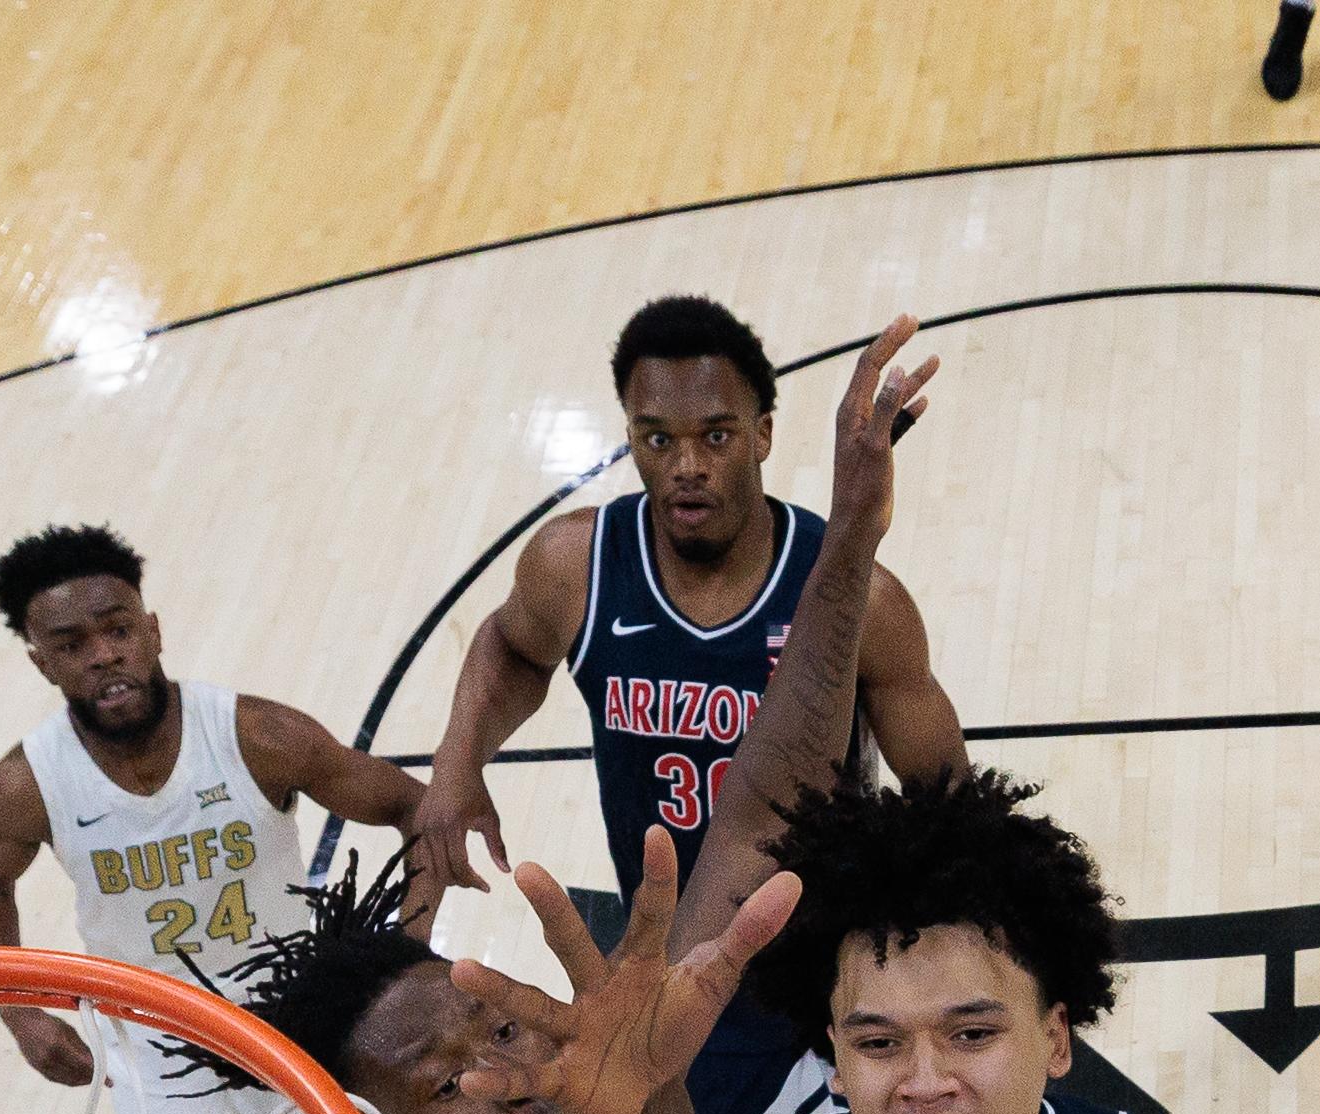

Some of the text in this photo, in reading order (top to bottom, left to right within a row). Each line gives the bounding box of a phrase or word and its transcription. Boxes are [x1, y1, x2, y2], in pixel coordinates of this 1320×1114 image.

[605, 676, 765, 744] ARIZO
[90, 820, 256, 894] BUFFS
[145, 878, 257, 954] 24
